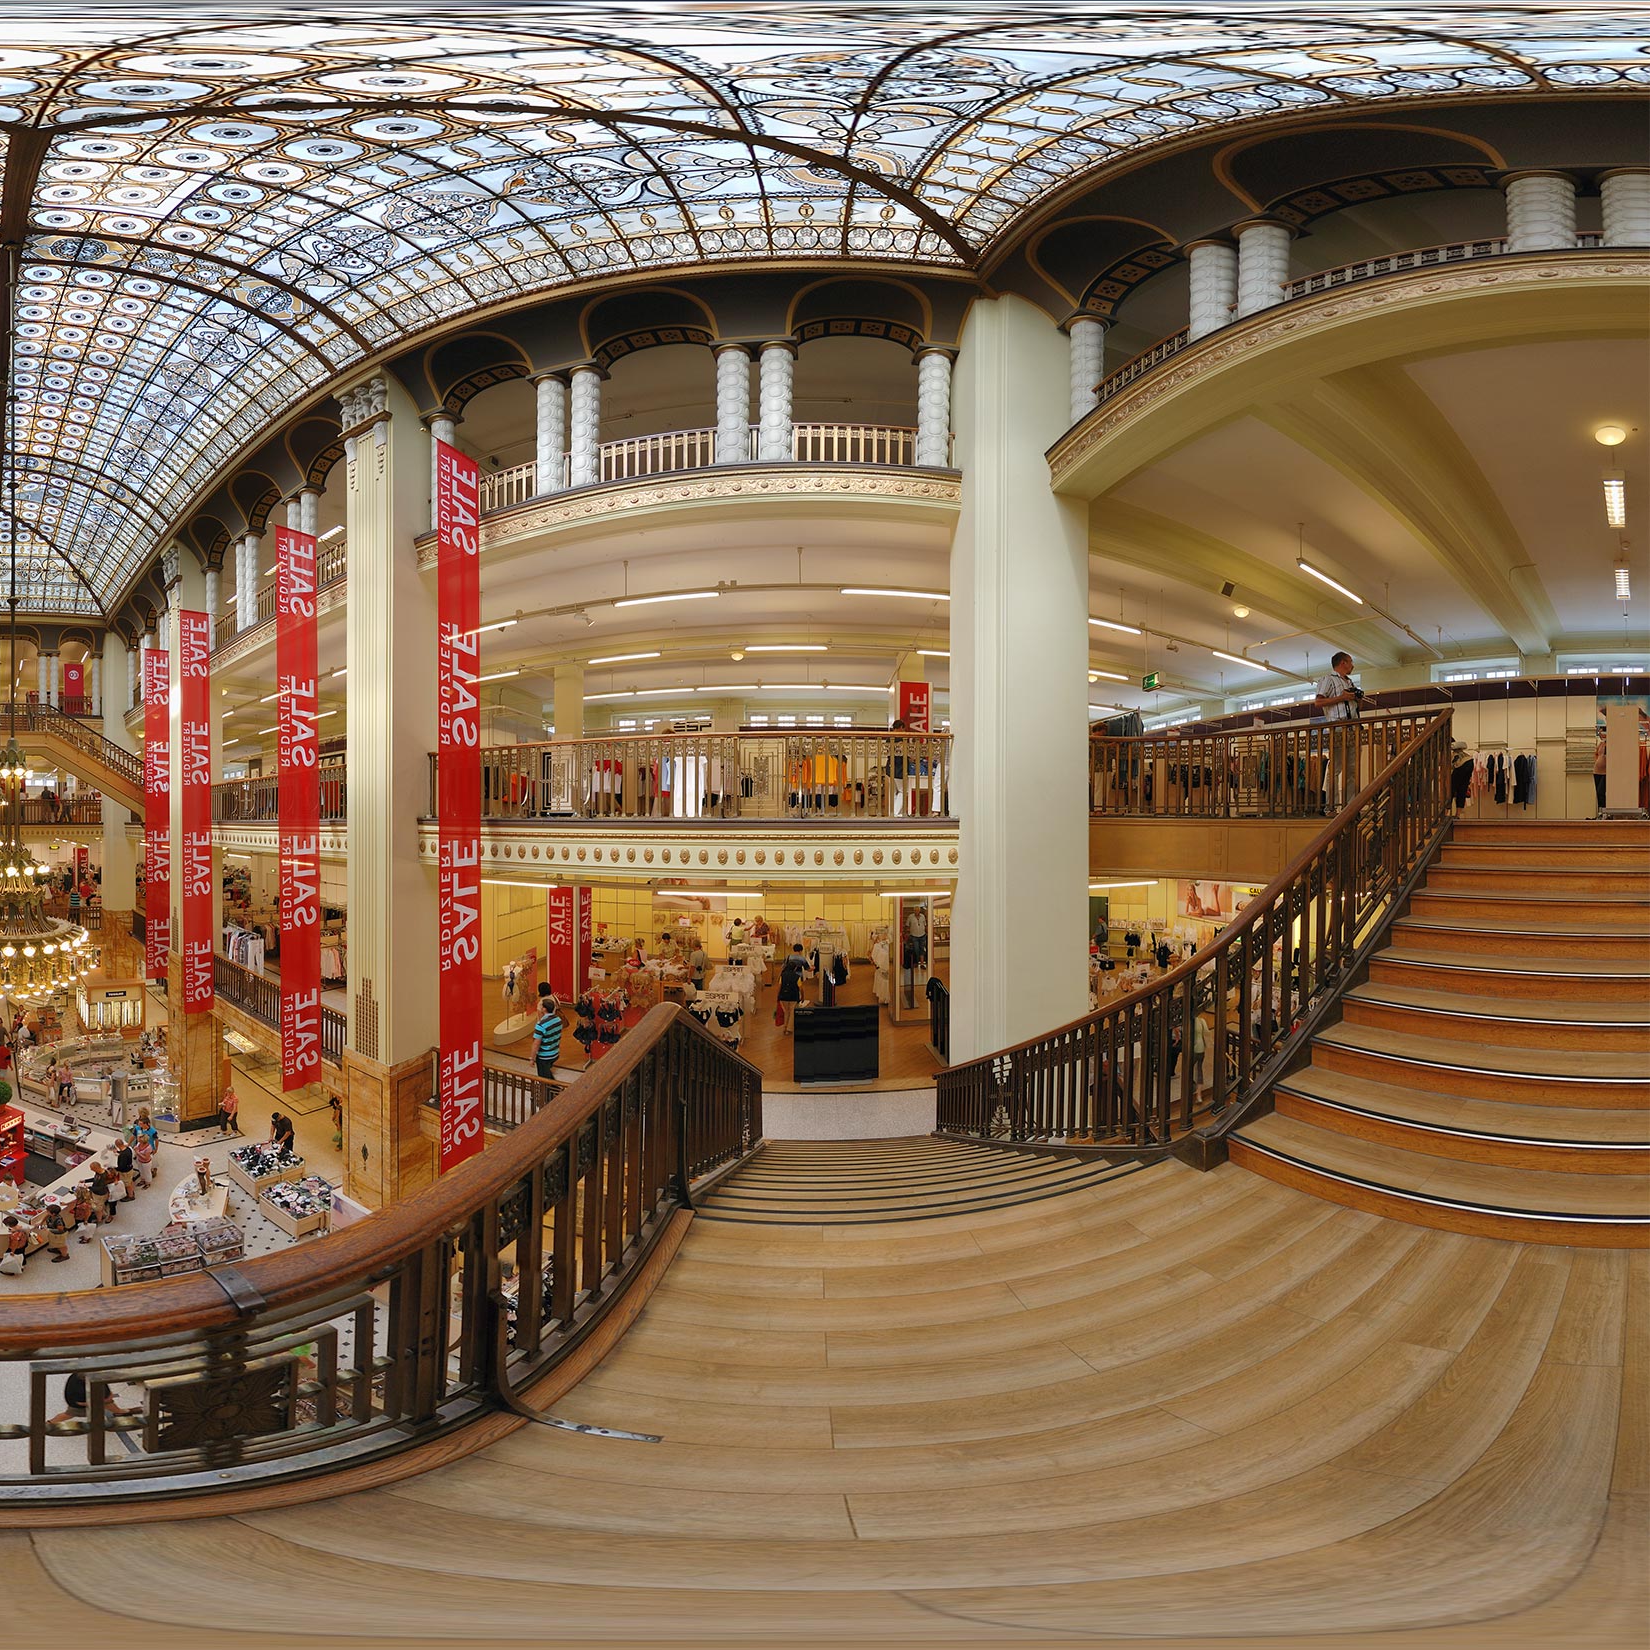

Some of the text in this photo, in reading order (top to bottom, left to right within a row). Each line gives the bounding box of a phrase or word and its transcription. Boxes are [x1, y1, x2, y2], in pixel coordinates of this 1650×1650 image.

[910, 693, 926, 732] ALE
[550, 896, 565, 945] SALE
[581, 894, 589, 943] SALE
[2, 1116, 22, 1131] Kasse
